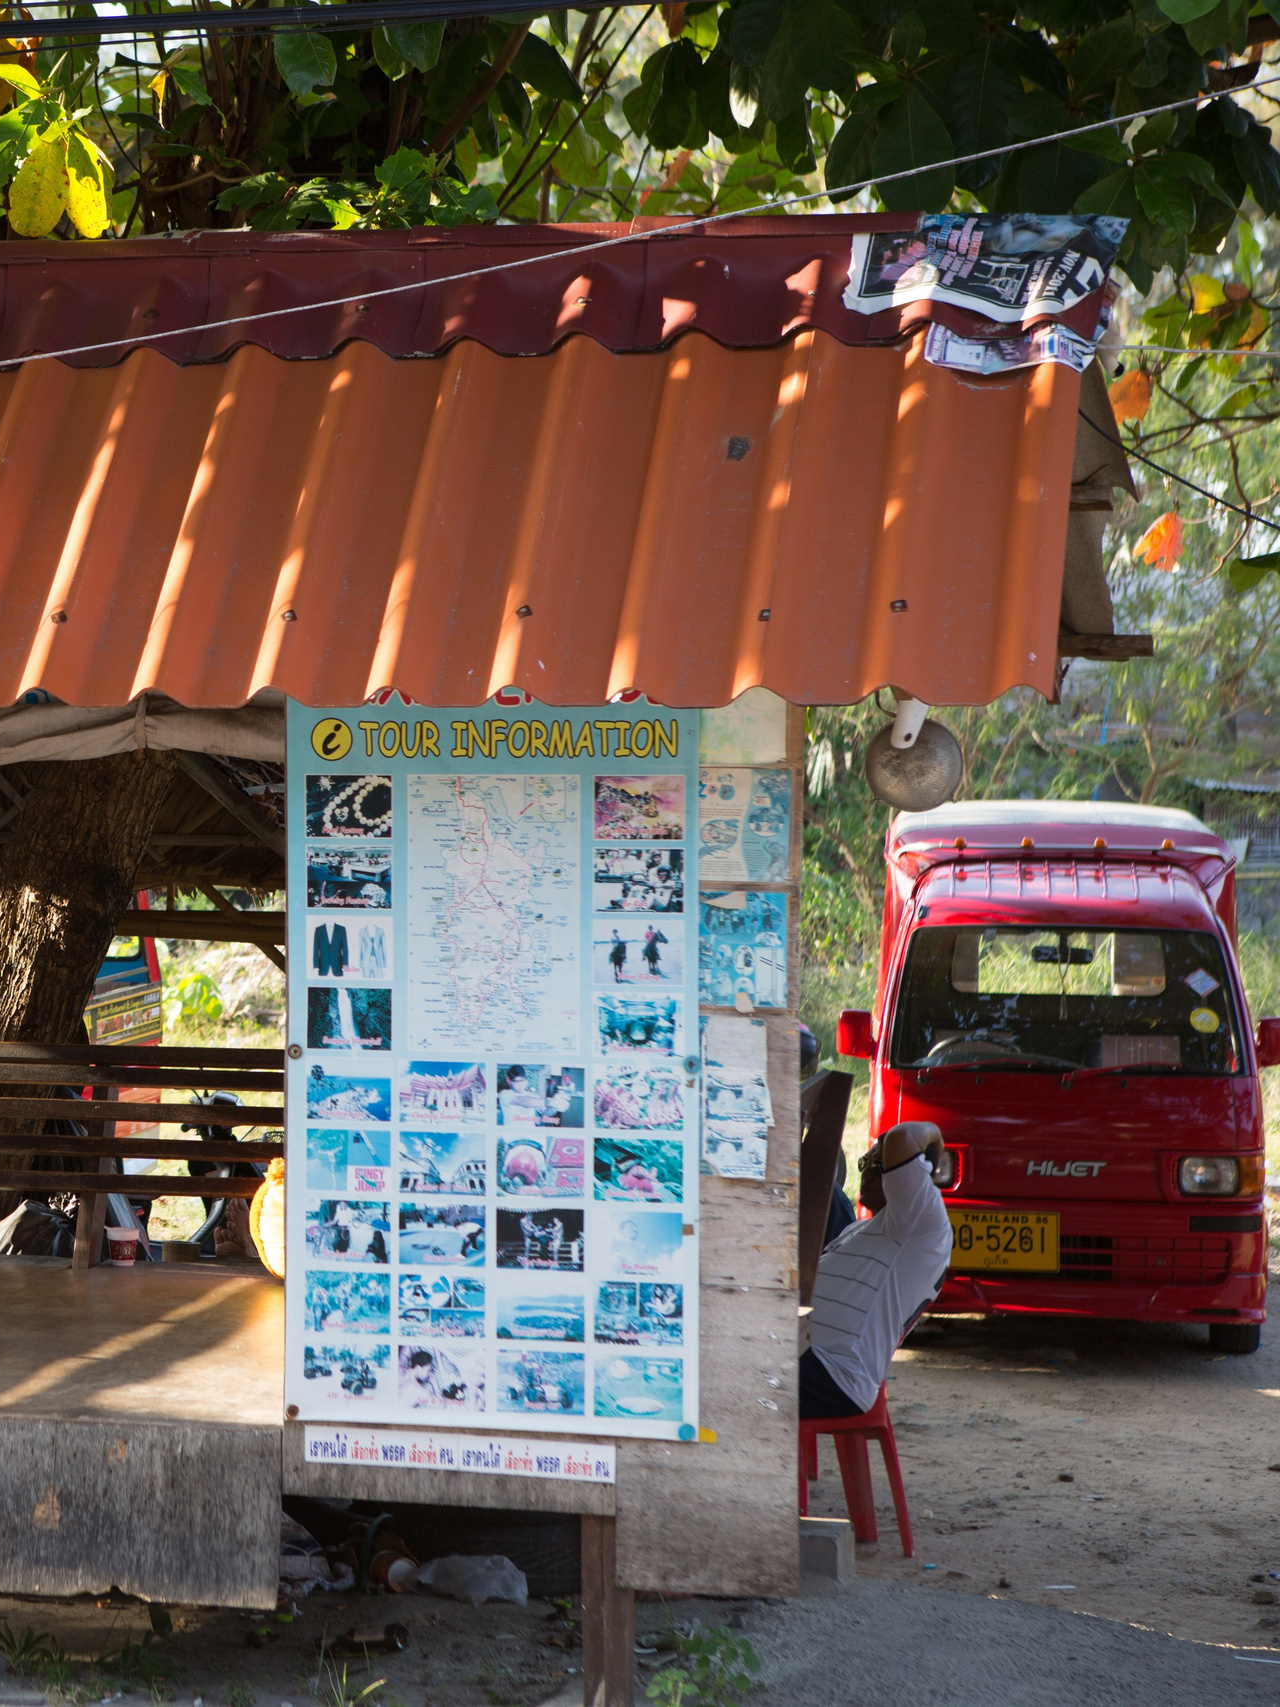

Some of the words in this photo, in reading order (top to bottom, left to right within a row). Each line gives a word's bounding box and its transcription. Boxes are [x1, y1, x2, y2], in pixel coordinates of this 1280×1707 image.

[358, 720, 441, 759] TOUR
[451, 720, 679, 759] INFORMATION
[355, 1168, 385, 1180] BUNGY
[1026, 1160, 1108, 1178] HIJET
[355, 1180, 385, 1192] JUMP
[963, 1213, 1029, 1224] THAILAND
[381, 1444, 406, 1462] พรรค
[440, 1447, 454, 1465] คน
[536, 1455, 561, 1474] พรรค
[595, 1459, 610, 1478] คน
